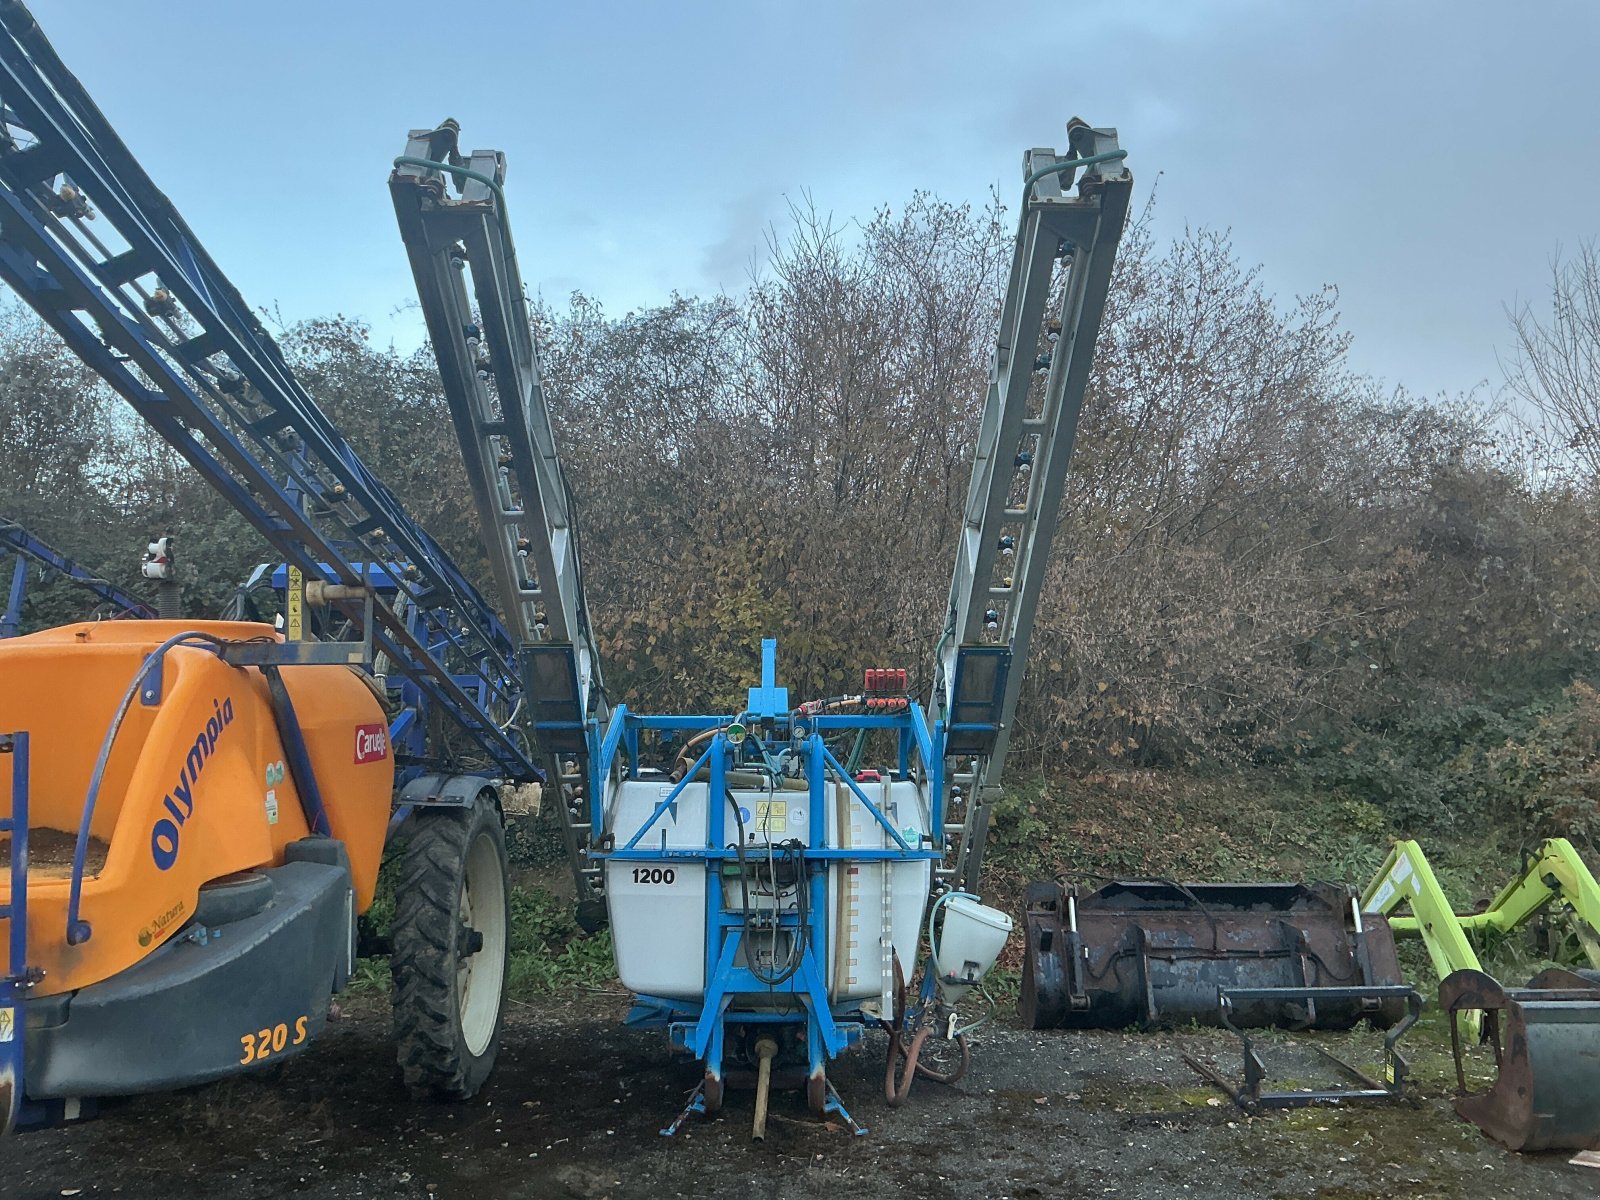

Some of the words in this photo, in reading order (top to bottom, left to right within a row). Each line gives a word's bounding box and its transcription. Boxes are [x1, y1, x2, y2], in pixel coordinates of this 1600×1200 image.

[152, 697, 234, 871] Olympia
[632, 868, 675, 885] 1200
[151, 900, 184, 934] Natura
[240, 1023, 288, 1065] 320
[292, 1015, 308, 1045] S
